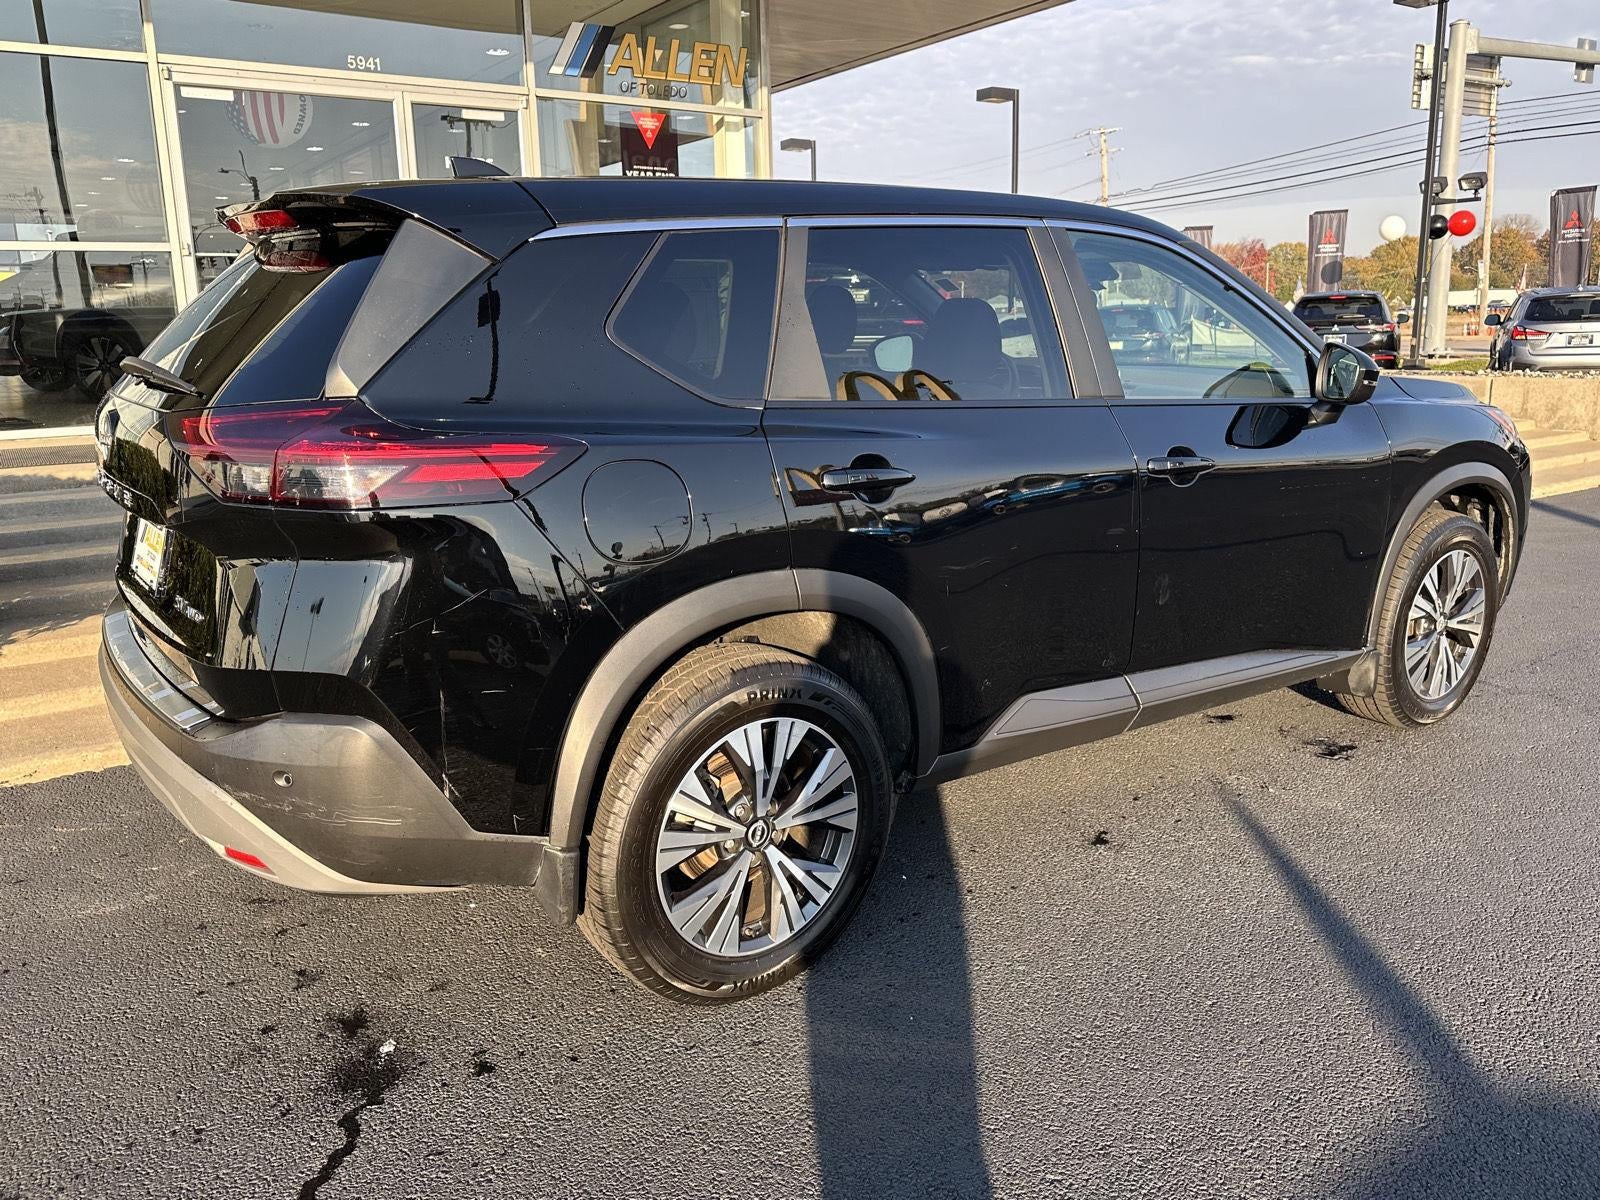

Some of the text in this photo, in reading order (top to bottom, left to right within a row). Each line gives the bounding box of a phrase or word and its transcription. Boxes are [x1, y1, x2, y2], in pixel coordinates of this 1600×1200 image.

[347, 54, 381, 71] 5941
[607, 32, 748, 88] ALLEN
[620, 81, 688, 99] OF TOLEDO
[293, 95, 307, 135] OWNED
[746, 687, 802, 704] PRINX
